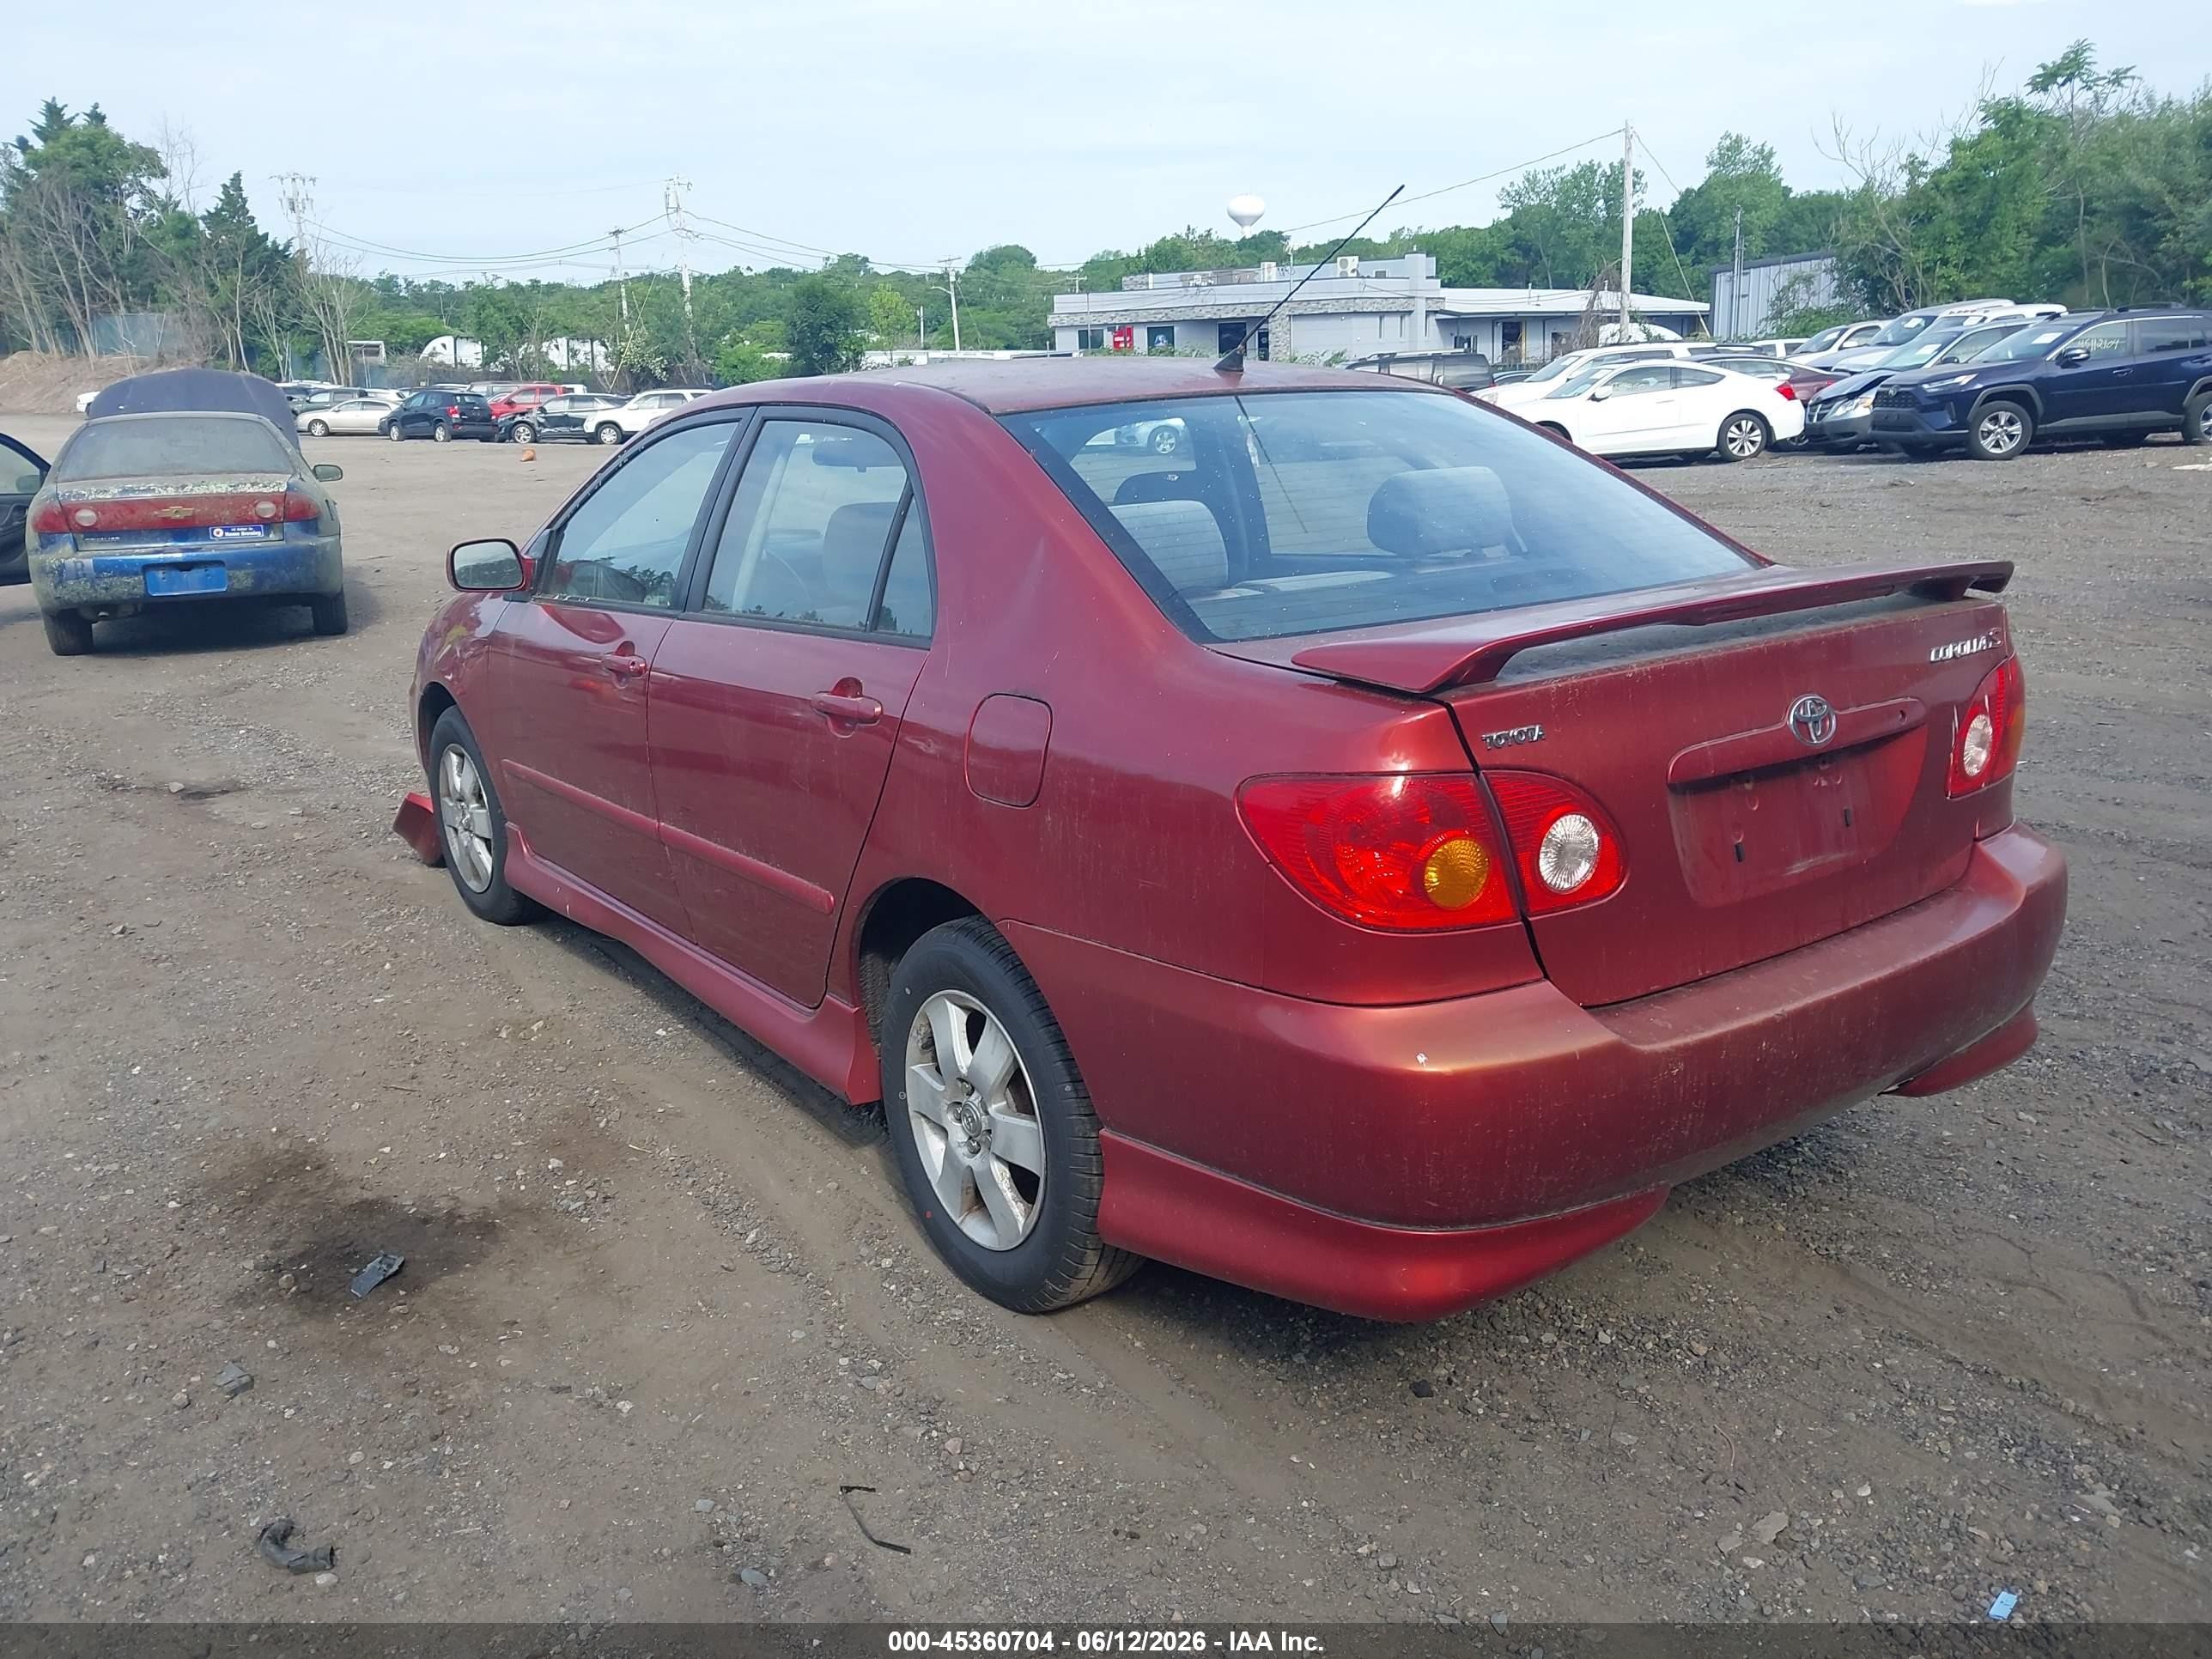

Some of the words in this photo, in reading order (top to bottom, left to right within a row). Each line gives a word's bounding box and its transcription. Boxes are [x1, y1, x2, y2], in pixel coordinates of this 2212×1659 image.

[1929, 635, 1987, 662] COROLLA
[1987, 627, 2003, 649] S
[1480, 724, 1546, 750] TOYOTA
